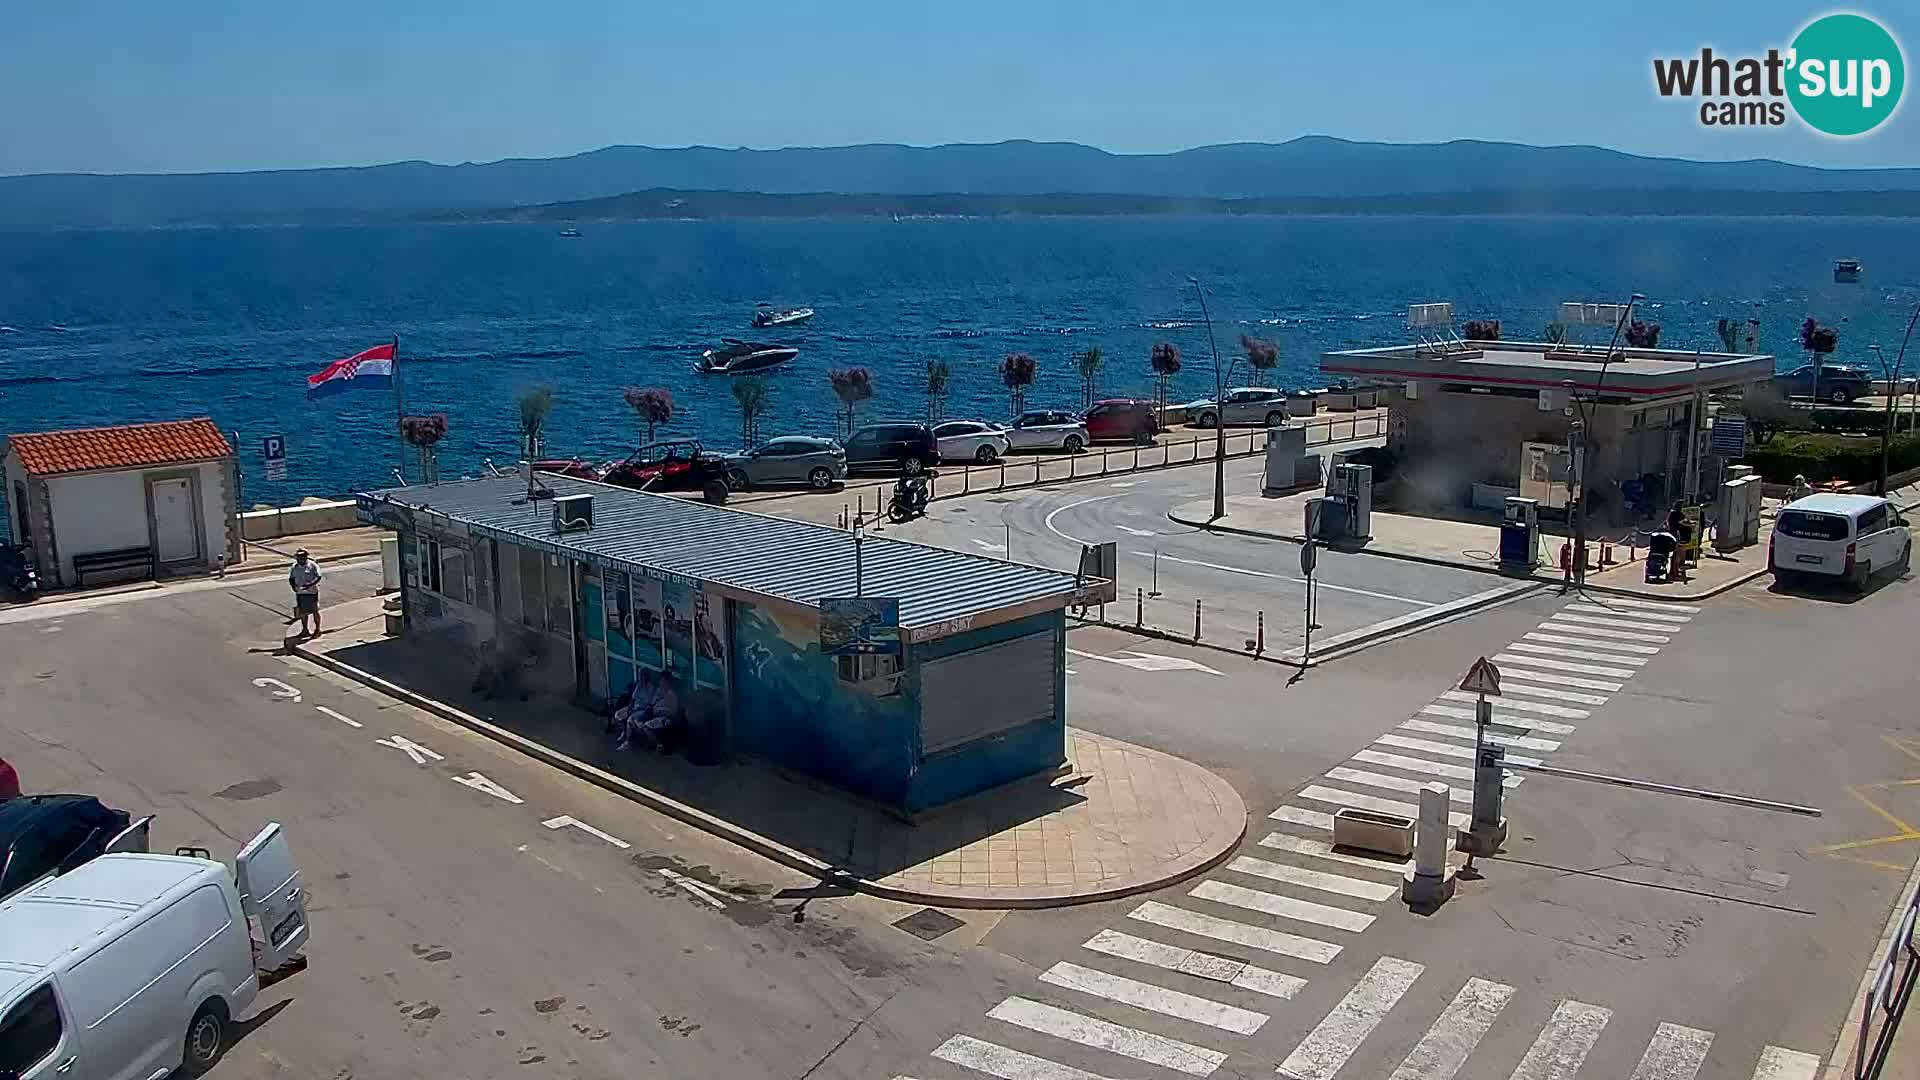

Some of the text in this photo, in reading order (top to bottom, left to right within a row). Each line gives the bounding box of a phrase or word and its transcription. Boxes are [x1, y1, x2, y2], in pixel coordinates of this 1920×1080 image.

[268, 439, 280, 456] P
[612, 559, 645, 575] STATION
[645, 567, 670, 582] TICKET
[672, 576, 698, 589] OFFICE
